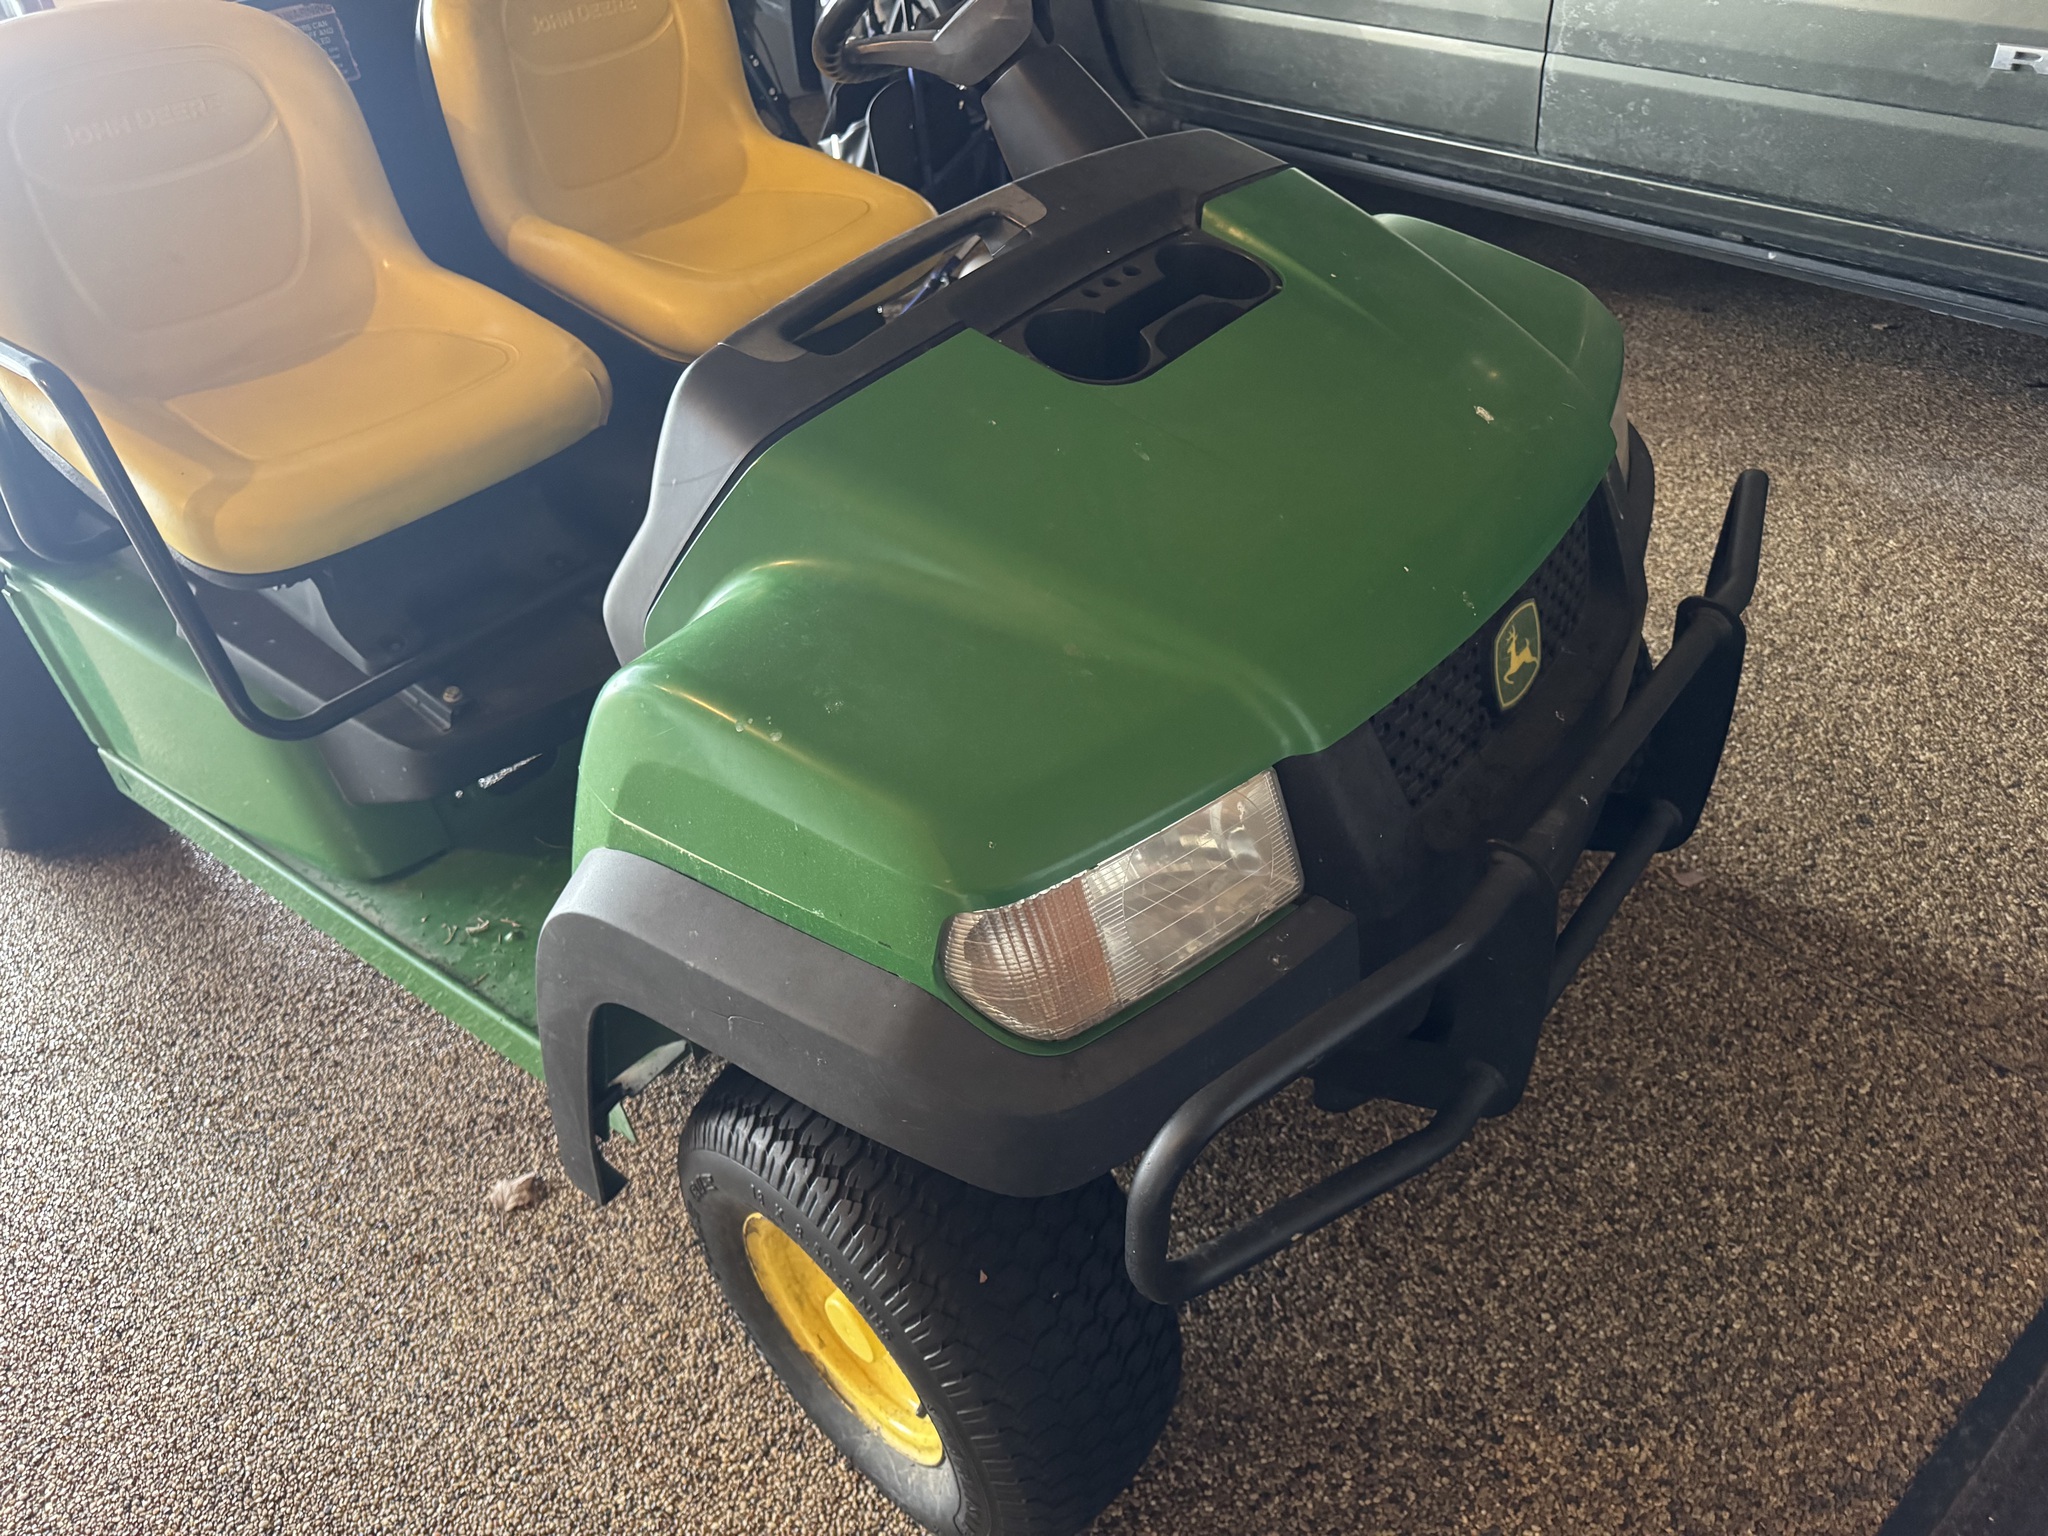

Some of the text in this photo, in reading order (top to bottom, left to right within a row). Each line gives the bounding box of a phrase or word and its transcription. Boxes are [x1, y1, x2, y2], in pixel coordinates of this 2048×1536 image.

[532, 0, 637, 37] JOHN DEERE
[63, 92, 222, 148] JOHN DEERE
